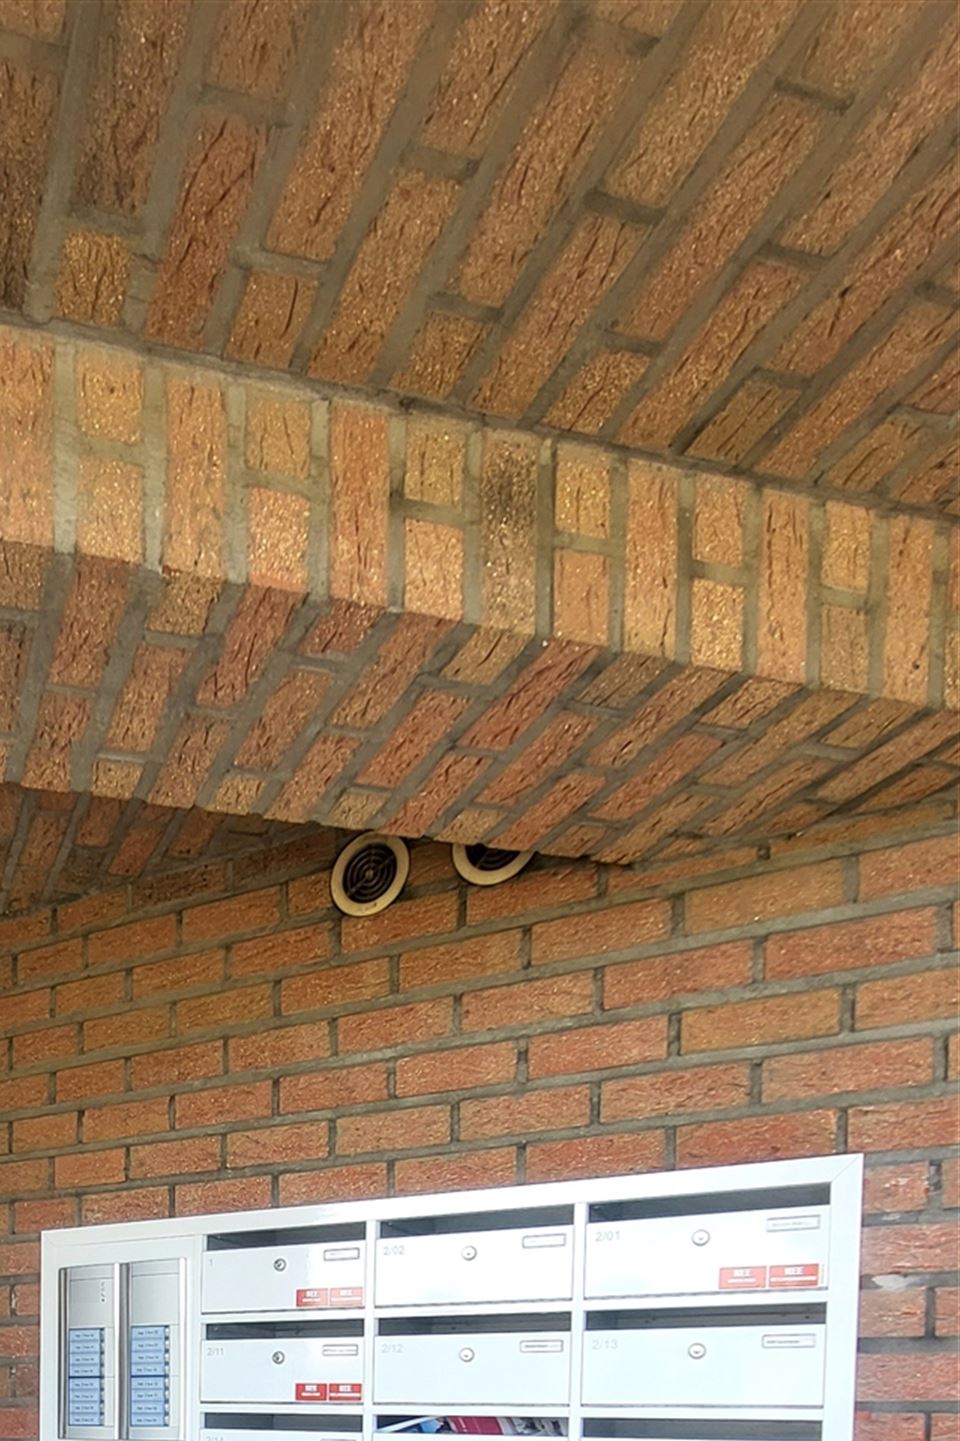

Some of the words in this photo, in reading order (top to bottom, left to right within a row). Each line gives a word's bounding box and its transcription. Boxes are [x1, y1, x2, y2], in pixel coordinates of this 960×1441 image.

[595, 1231, 620, 1242] 2/01
[383, 1245, 405, 1256] 2/02
[381, 1343, 404, 1353] 2/12
[592, 1339, 618, 1350] 2/13
[207, 1347, 224, 1356] 2/11
